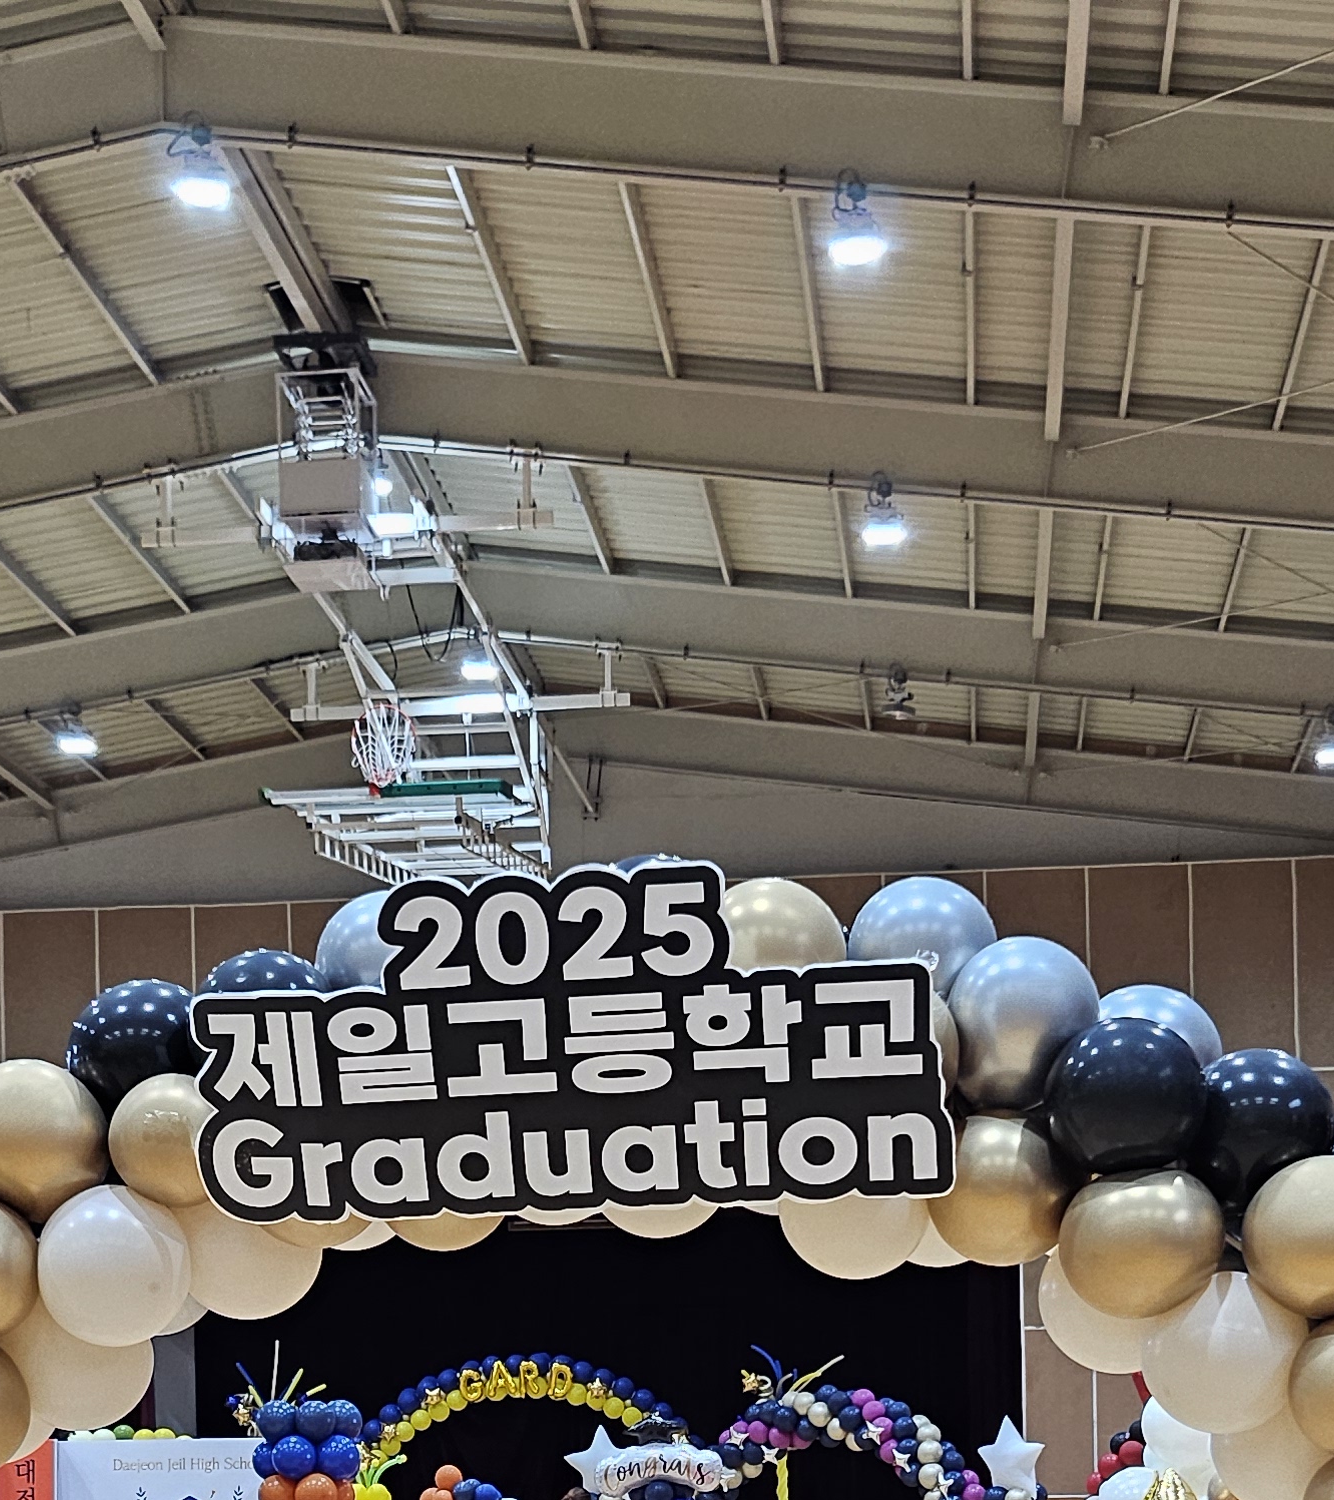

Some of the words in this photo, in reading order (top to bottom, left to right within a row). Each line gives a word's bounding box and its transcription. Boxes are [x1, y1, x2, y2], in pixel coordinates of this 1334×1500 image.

[397, 881, 715, 990] 2025
[206, 978, 923, 1108] 제일고등학교
[212, 1098, 939, 1208] Graduation
[460, 1360, 573, 1402] GARD
[112, 1458, 164, 1473] Daejeon
[166, 1457, 187, 1473] Jeil
[190, 1456, 221, 1474] High
[223, 1456, 253, 1470] Scho
[603, 1453, 710, 1491] Congrats
